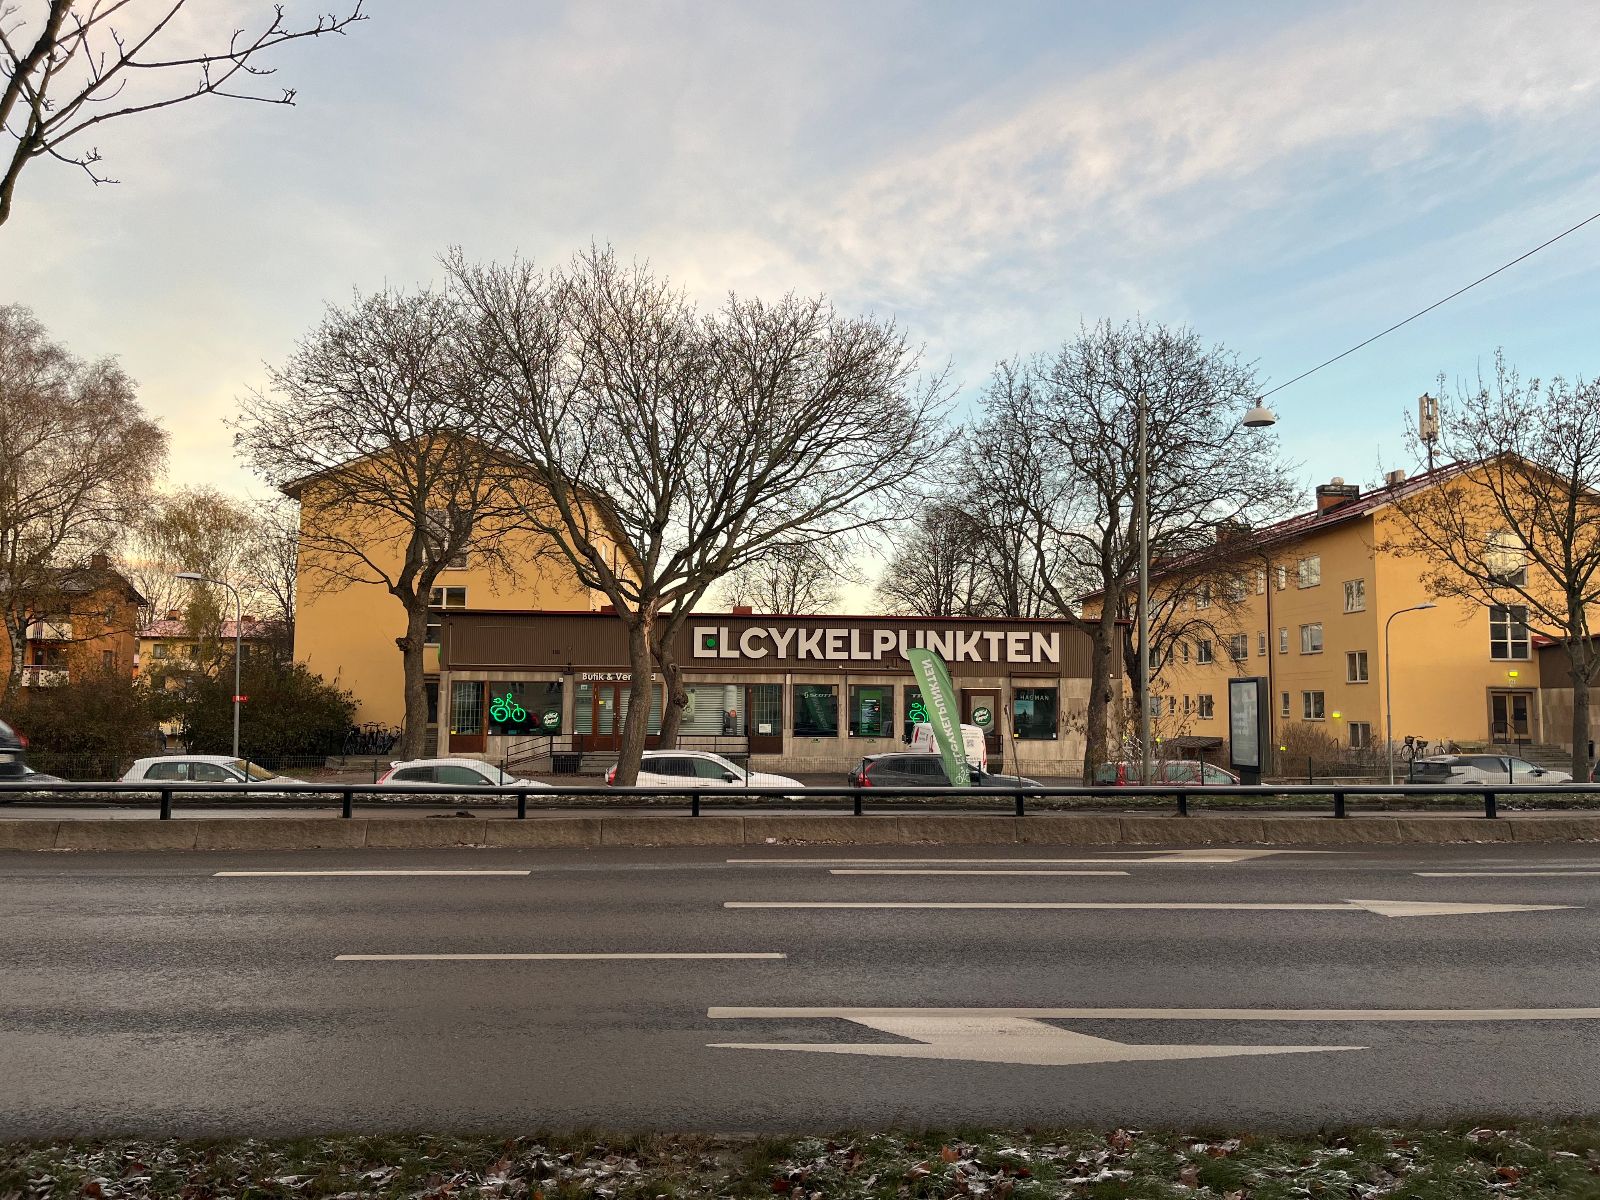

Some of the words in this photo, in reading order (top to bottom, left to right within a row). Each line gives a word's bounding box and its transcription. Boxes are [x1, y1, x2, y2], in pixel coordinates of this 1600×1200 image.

[693, 626, 1060, 662] ELCYKELPUNKTEN
[582, 672, 604, 681] Butik
[606, 673, 613, 681] &
[615, 672, 656, 681] Verd
